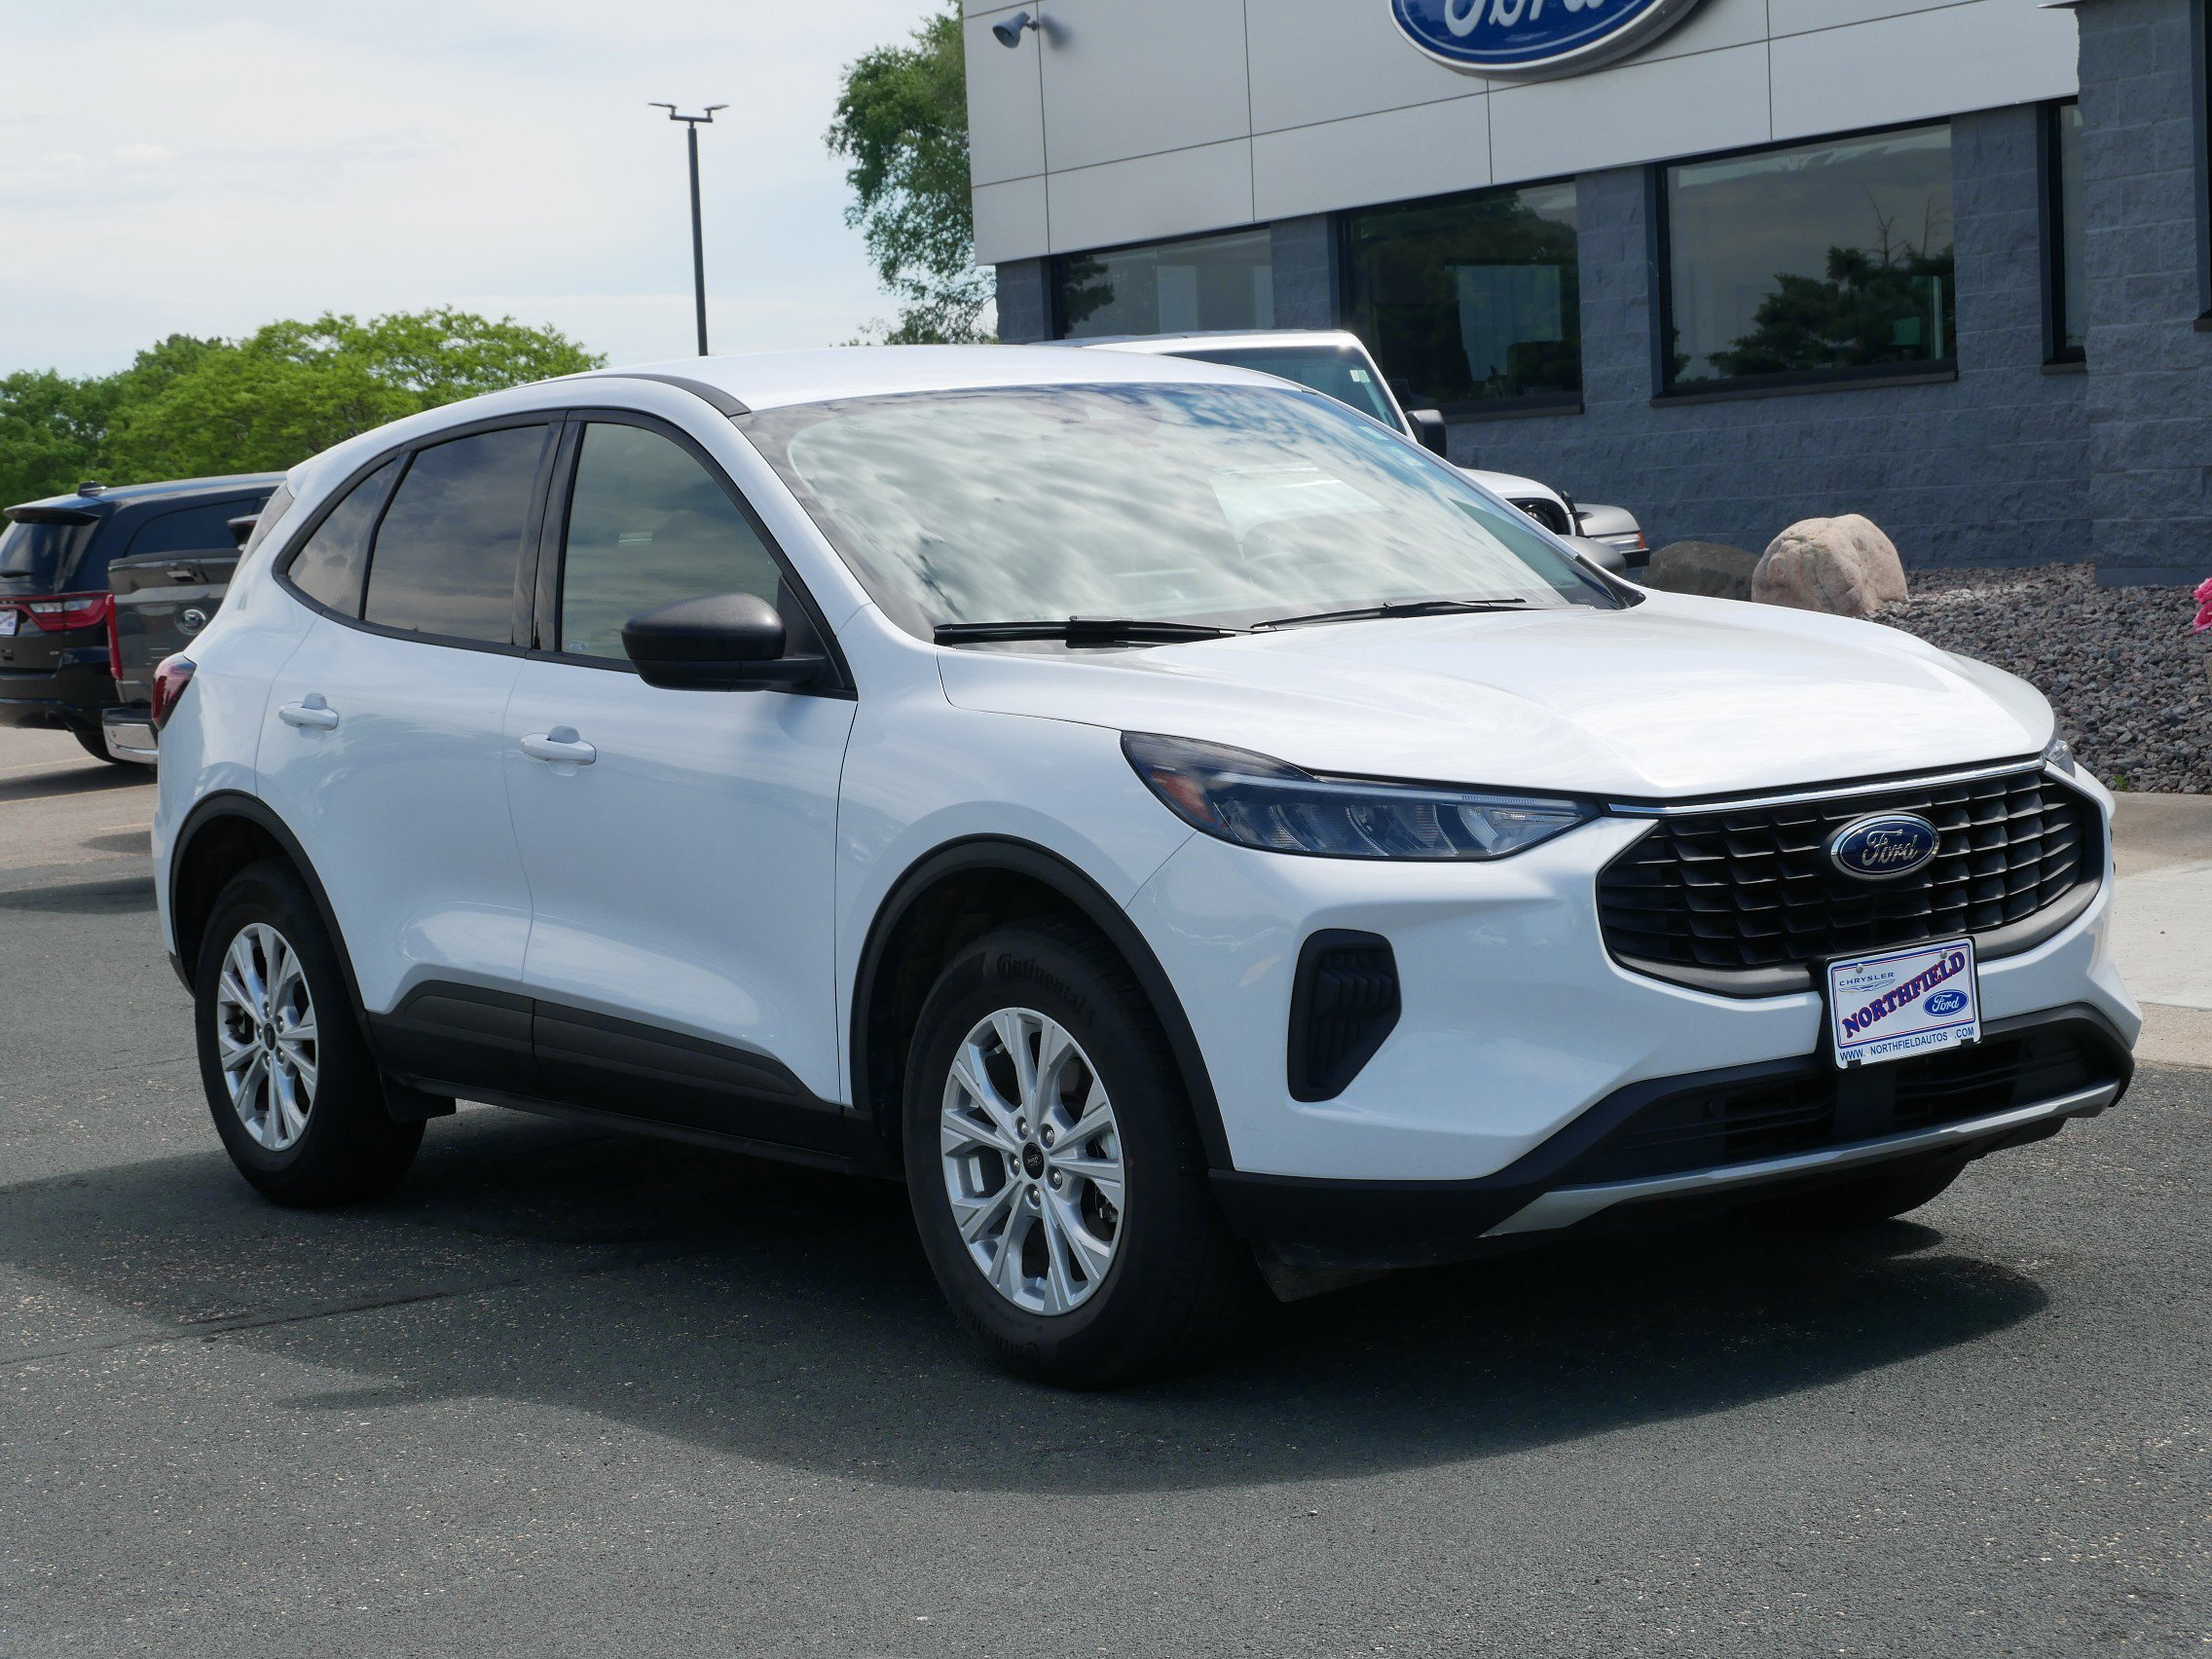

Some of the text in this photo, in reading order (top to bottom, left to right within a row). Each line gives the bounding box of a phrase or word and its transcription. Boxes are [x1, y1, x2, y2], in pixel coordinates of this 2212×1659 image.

[1862, 829, 1918, 866] Ford
[1839, 972, 1895, 986] CHRYSLER
[1841, 951, 1966, 1039] NORTHFIELD
[1932, 994, 1960, 1013] Ford
[1869, 1032, 1948, 1056] NORTHFIELDAUTOS
